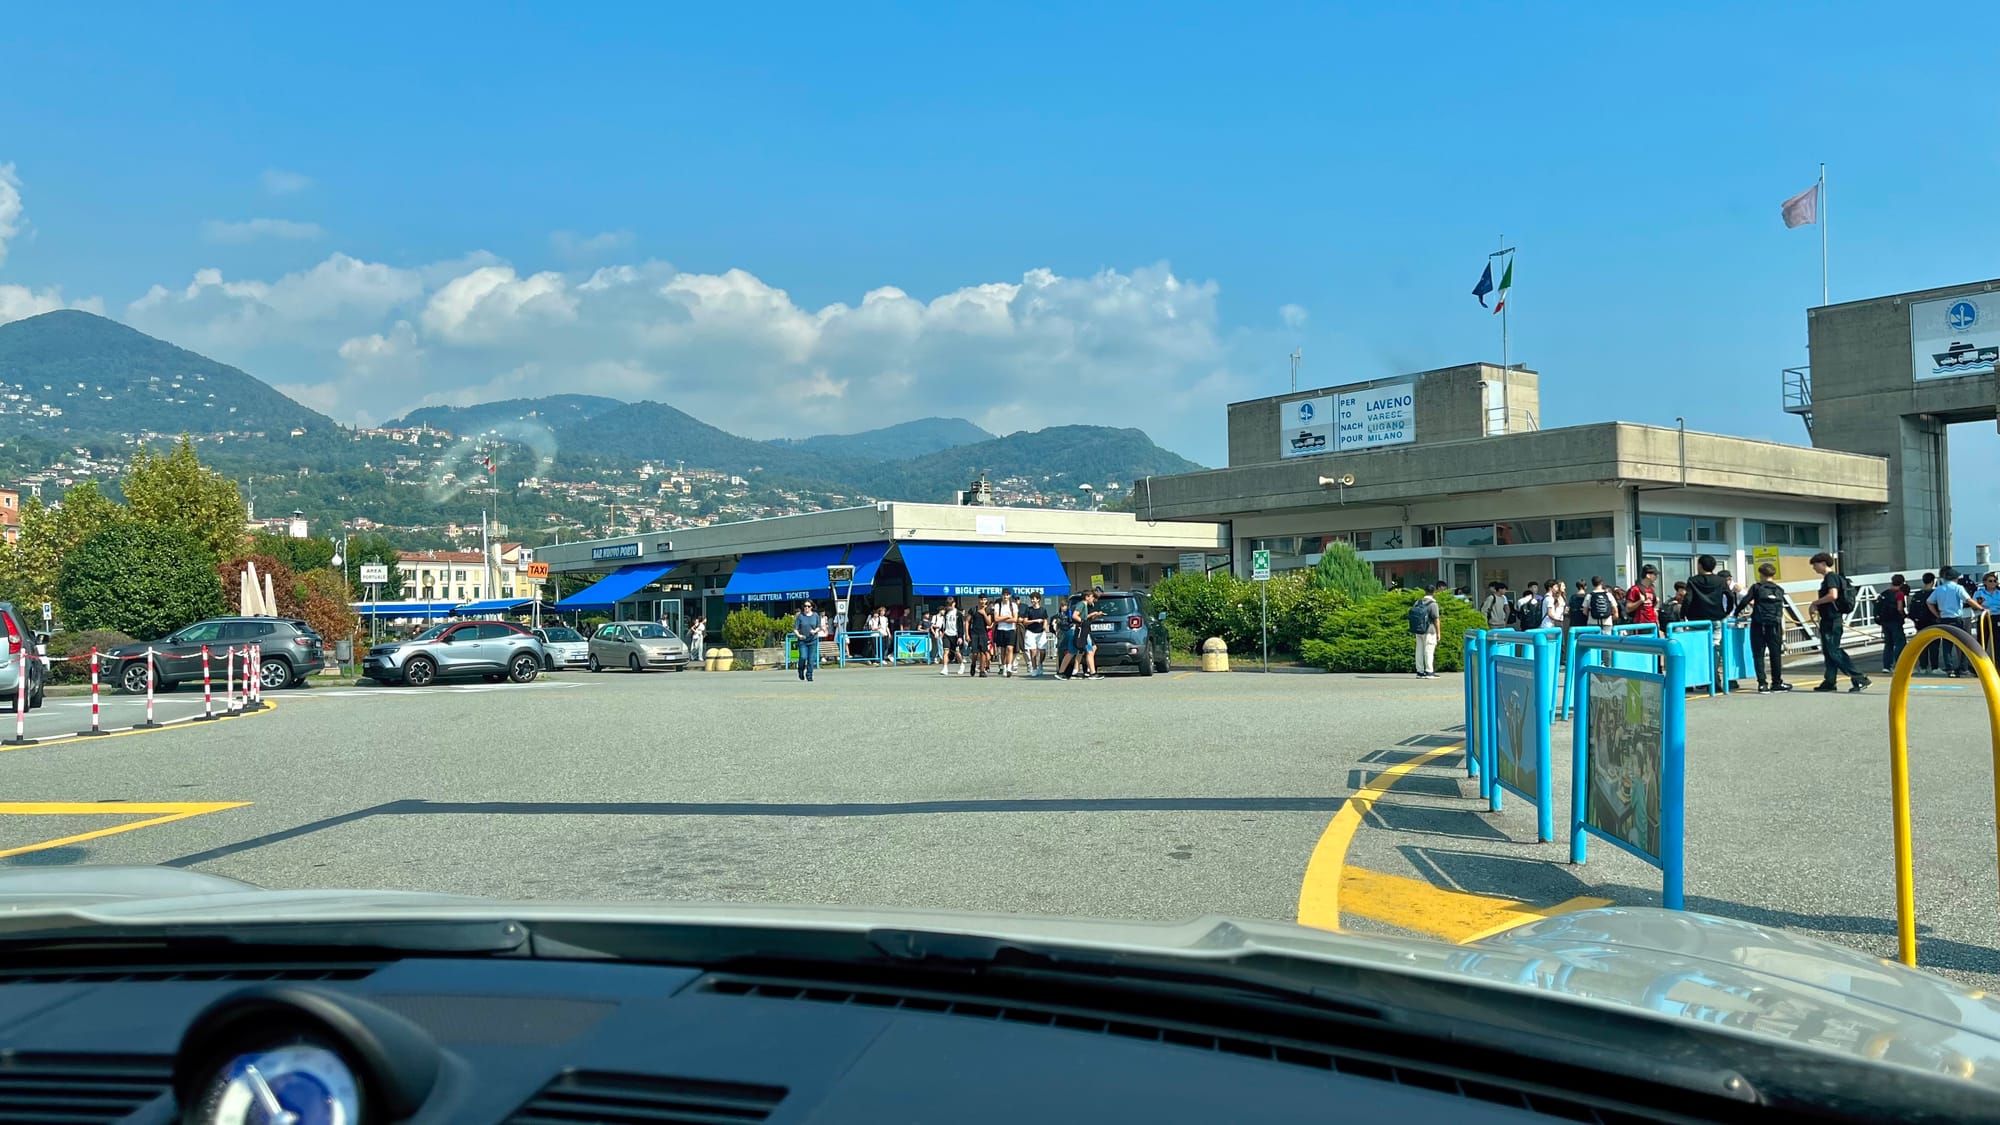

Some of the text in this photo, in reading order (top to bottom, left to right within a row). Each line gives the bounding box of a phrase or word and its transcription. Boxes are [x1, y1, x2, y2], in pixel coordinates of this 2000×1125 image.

[1340, 395, 1412, 411] PER LAVENO
[1341, 410, 1403, 421] TO VARESE
[1341, 420, 1405, 433] NACH LUGANO
[1341, 431, 1403, 444] POUR MILANO
[530, 565, 548, 576] TAXI
[955, 586, 1003, 595] BIGLIETTERI
[747, 591, 810, 602] BIGLIETTERIA TICKETS
